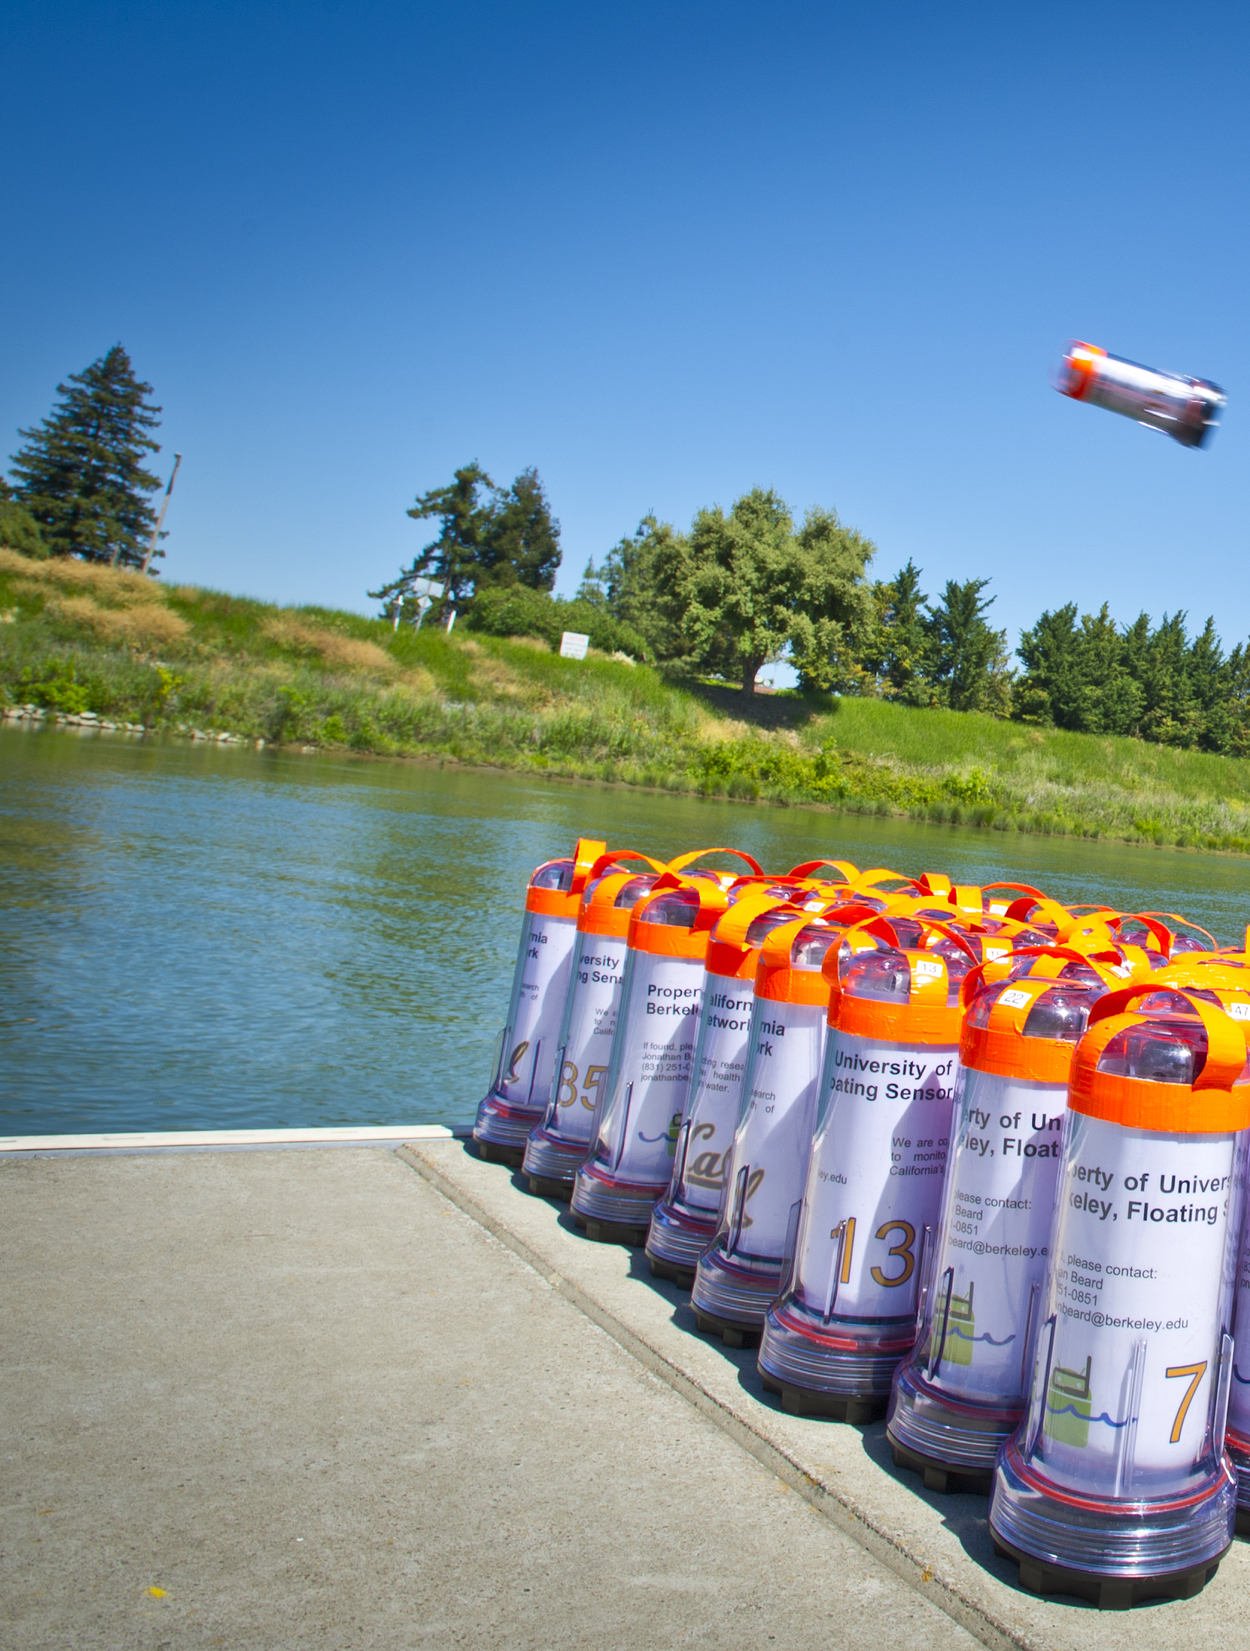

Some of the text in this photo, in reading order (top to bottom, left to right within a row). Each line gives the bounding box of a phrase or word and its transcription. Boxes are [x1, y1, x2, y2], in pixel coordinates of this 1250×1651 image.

[922, 962, 937, 974] 13
[1004, 992, 1024, 1004] 22
[650, 1042, 677, 1051] found,
[642, 1063, 664, 1072] (831)
[834, 1050, 953, 1080] University of
[713, 1071, 740, 1082] health
[752, 1088, 776, 1100] earch
[885, 1083, 954, 1101] Sensor
[766, 1104, 774, 1114] of
[966, 1108, 991, 1130] rty
[1000, 1112, 1022, 1129] of
[892, 1138, 912, 1148] We
[916, 1139, 934, 1148] are
[962, 1132, 1059, 1158] ley, Float
[891, 1152, 902, 1162] to
[1124, 1174, 1150, 1192] of
[984, 1198, 1032, 1210] contact:
[955, 1205, 984, 1220] Beard
[1127, 1200, 1218, 1225] Floating
[830, 1216, 916, 1288] 13
[1067, 1254, 1158, 1280] please contact:
[1070, 1273, 1104, 1290] Beard
[1165, 1360, 1208, 1444] 7
